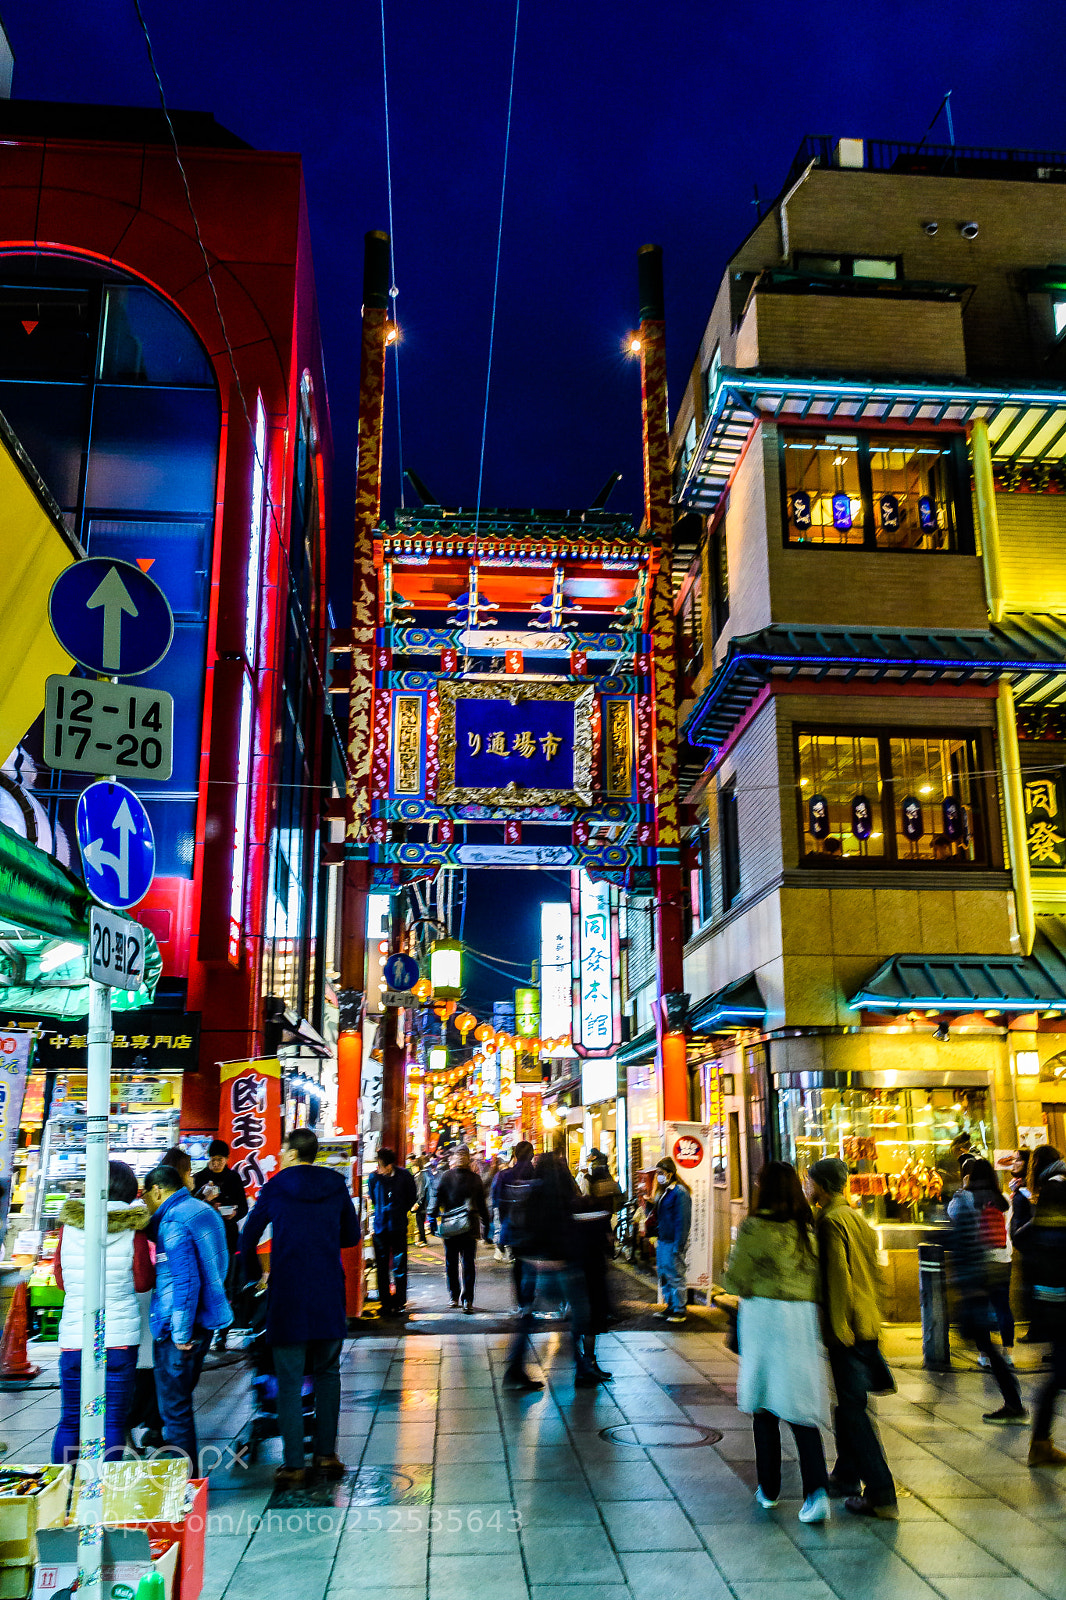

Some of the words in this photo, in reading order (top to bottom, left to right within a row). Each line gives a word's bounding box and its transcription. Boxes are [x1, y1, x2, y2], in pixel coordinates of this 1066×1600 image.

[56, 686, 162, 732] 12-14
[54, 724, 162, 769] 17-20
[49, 1034, 193, 1049] 中華品専門店
